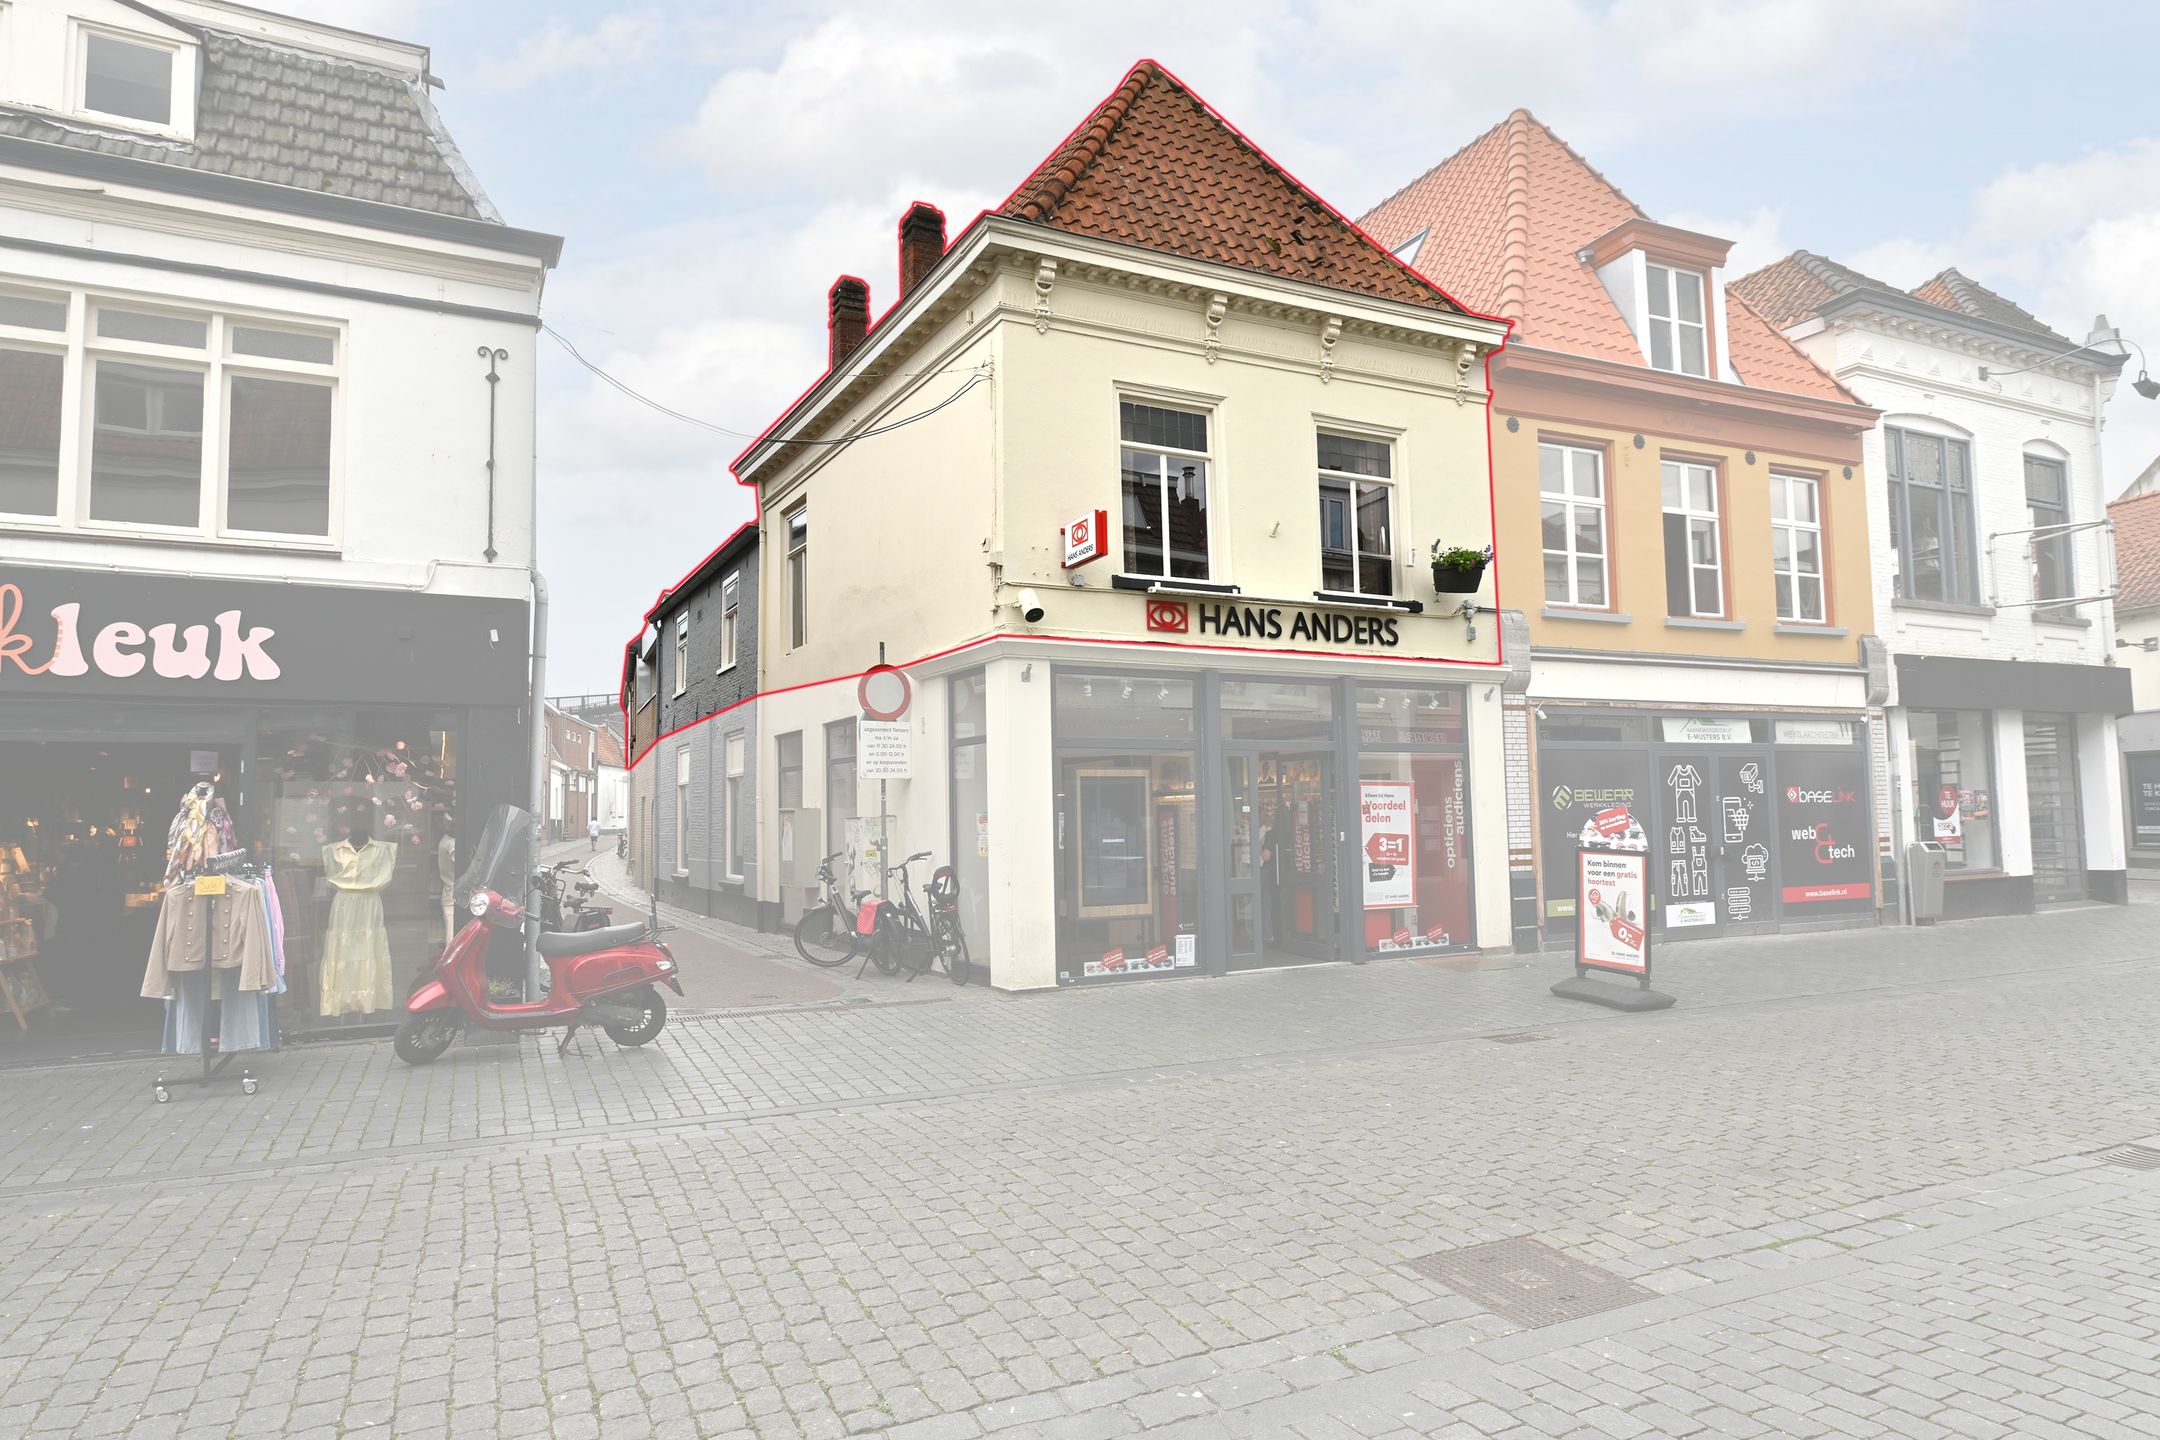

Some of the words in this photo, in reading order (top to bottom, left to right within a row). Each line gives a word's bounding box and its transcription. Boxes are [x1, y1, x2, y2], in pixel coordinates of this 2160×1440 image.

[1199, 603, 1282, 639] HANS
[1290, 611, 1398, 647] ANDERS
[48, 602, 281, 681] leuk
[1452, 760, 1465, 835] audiciens
[1573, 788, 1634, 802] BEWEAR
[1940, 800, 1956, 808] HUUR
[1944, 791, 1952, 799] TE
[1365, 813, 1391, 823] delen
[1444, 796, 1456, 869] opticiens
[1791, 825, 1817, 841] web
[1828, 844, 1856, 860] tech
[1161, 819, 1170, 896] opticiens
[1167, 816, 1177, 896] audiciens
[1587, 859, 1602, 867] Kom
[1602, 860, 1627, 869] binnen
[1587, 877, 1616, 887] hoortest
[1616, 871, 1638, 881] gratis
